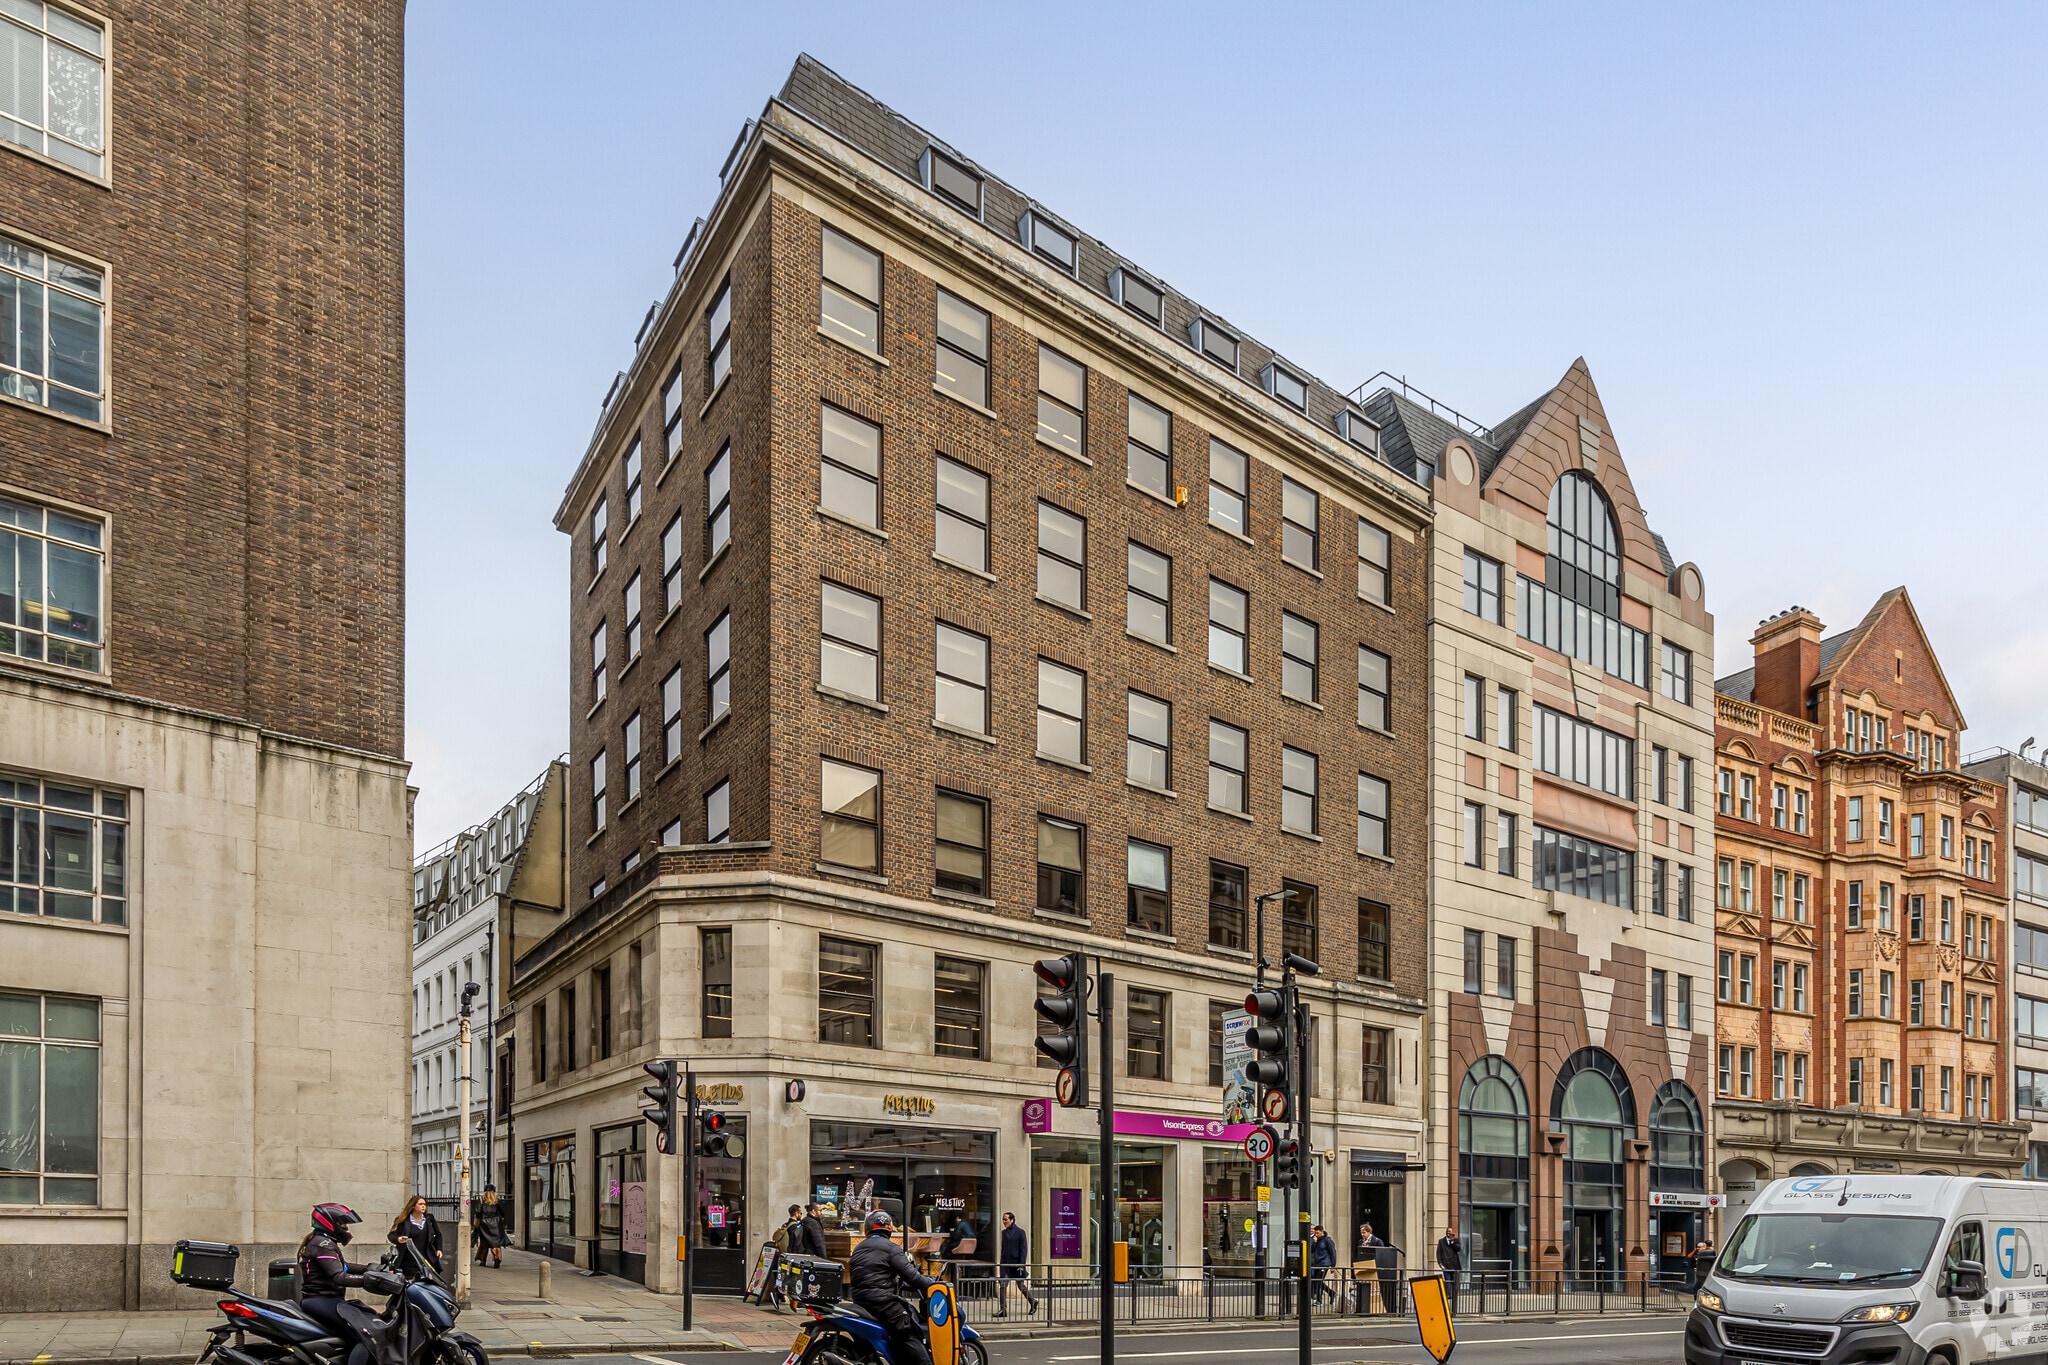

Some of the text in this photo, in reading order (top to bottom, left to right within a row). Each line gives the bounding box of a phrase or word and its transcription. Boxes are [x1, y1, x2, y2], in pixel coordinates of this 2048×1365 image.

[1226, 1020, 1250, 1029] SCREWFIX
[883, 1094, 937, 1112] MELETIUS
[1162, 1119, 1205, 1132] VisionExpress
[1249, 1138, 1269, 1153] 20
[1361, 1168, 1376, 1177] HIGH
[1377, 1168, 1404, 1178] HOLBORN
[935, 1197, 965, 1208] MELETIUS
[1996, 1228, 2032, 1279] GD
